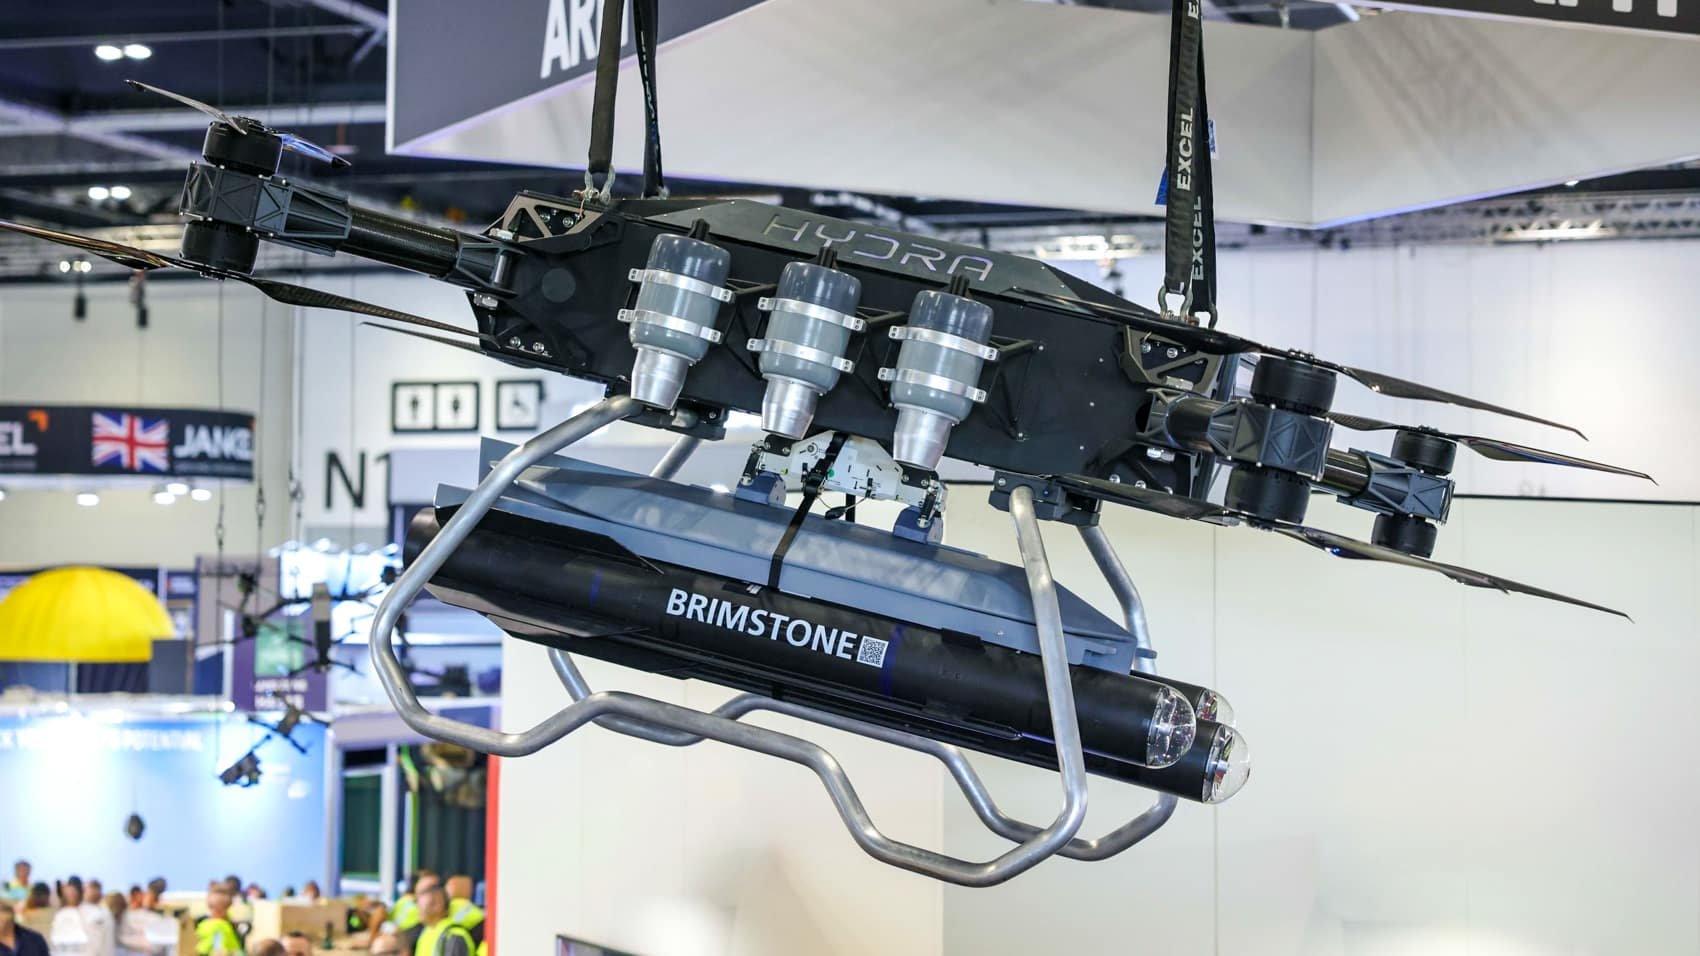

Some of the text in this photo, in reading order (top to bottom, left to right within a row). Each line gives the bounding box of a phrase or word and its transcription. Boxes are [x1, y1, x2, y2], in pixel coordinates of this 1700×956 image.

[1176, 107, 1193, 191] EXCEL
[763, 214, 994, 282] HYDRA
[1192, 195, 1204, 281] EXCEL
[665, 588, 858, 660] BRIMSTONE
